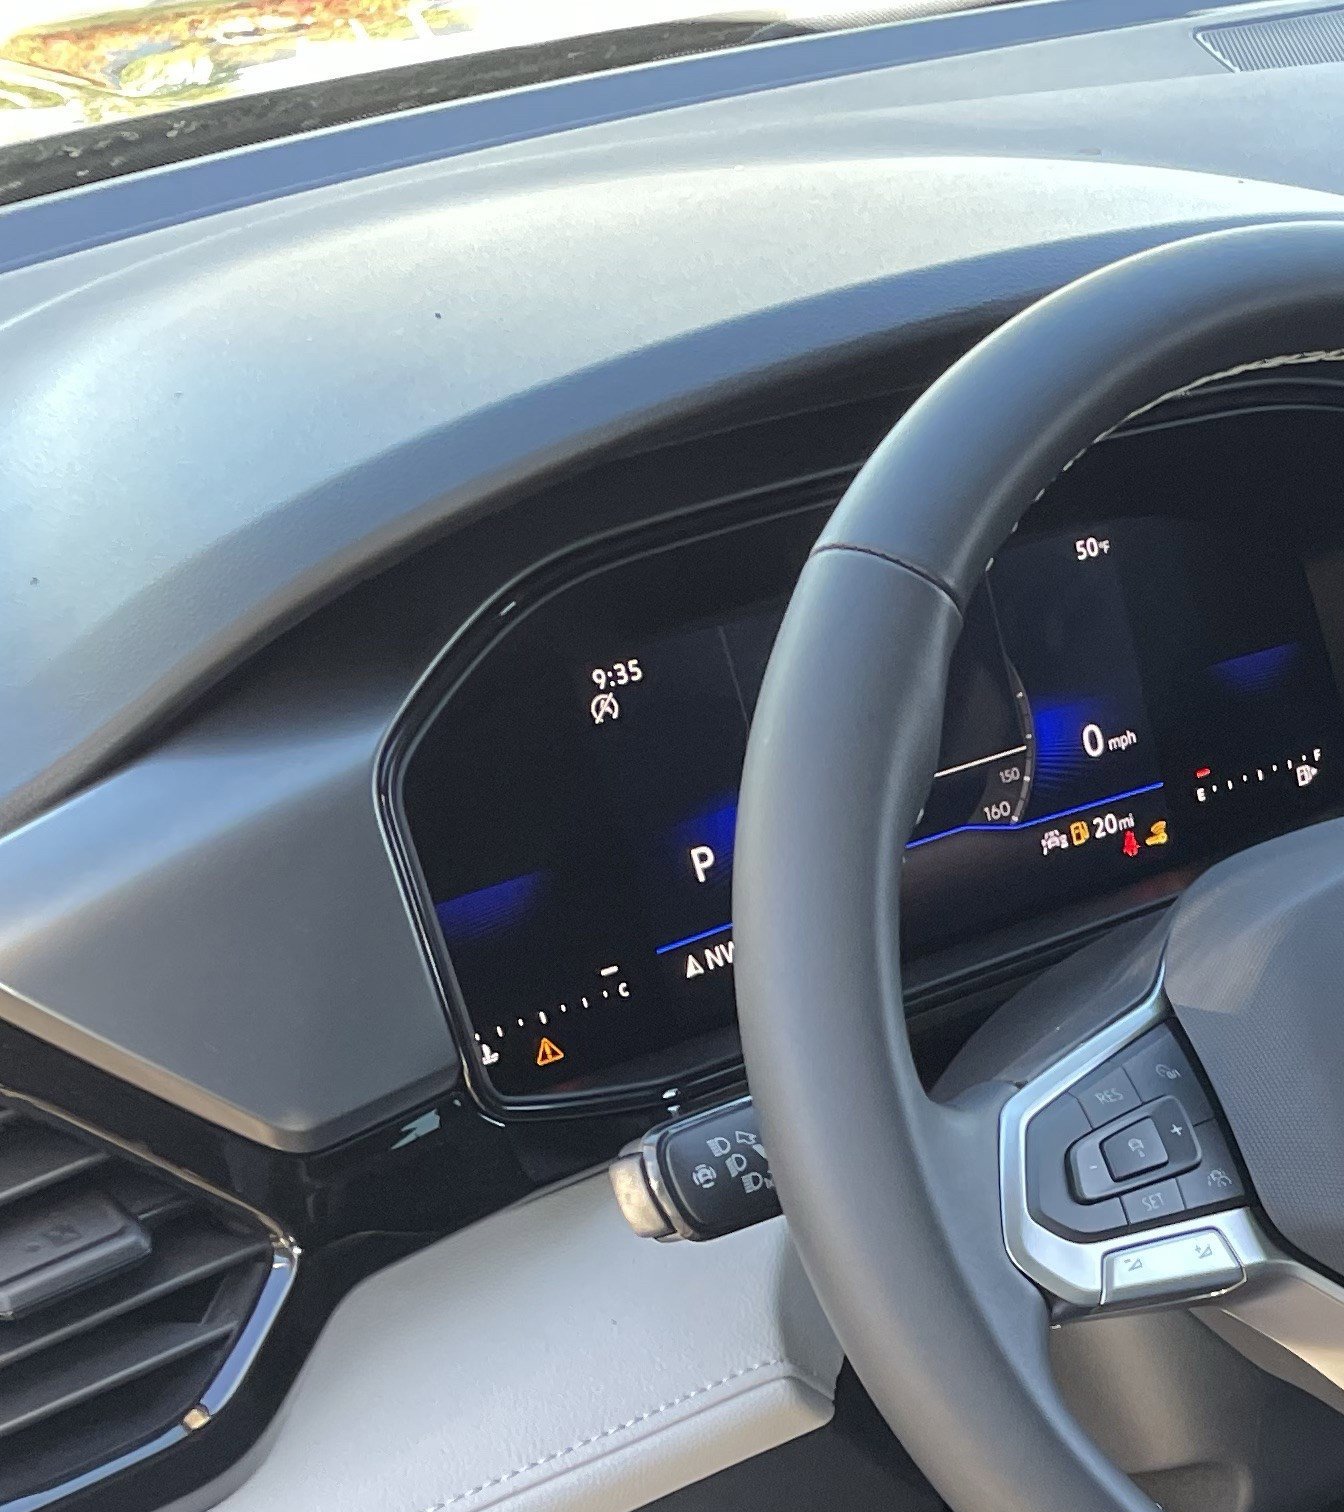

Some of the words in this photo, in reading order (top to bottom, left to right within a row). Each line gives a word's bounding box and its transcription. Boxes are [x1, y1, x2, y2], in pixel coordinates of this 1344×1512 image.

[592, 659, 642, 690] 9:35
[1082, 724, 1104, 757] 0
[1108, 730, 1137, 753] mph
[999, 767, 1020, 783] 150
[984, 801, 1011, 822] 160
[690, 846, 715, 883] P
[1094, 1087, 1123, 1104] RES
[1141, 1192, 1165, 1212] SET
